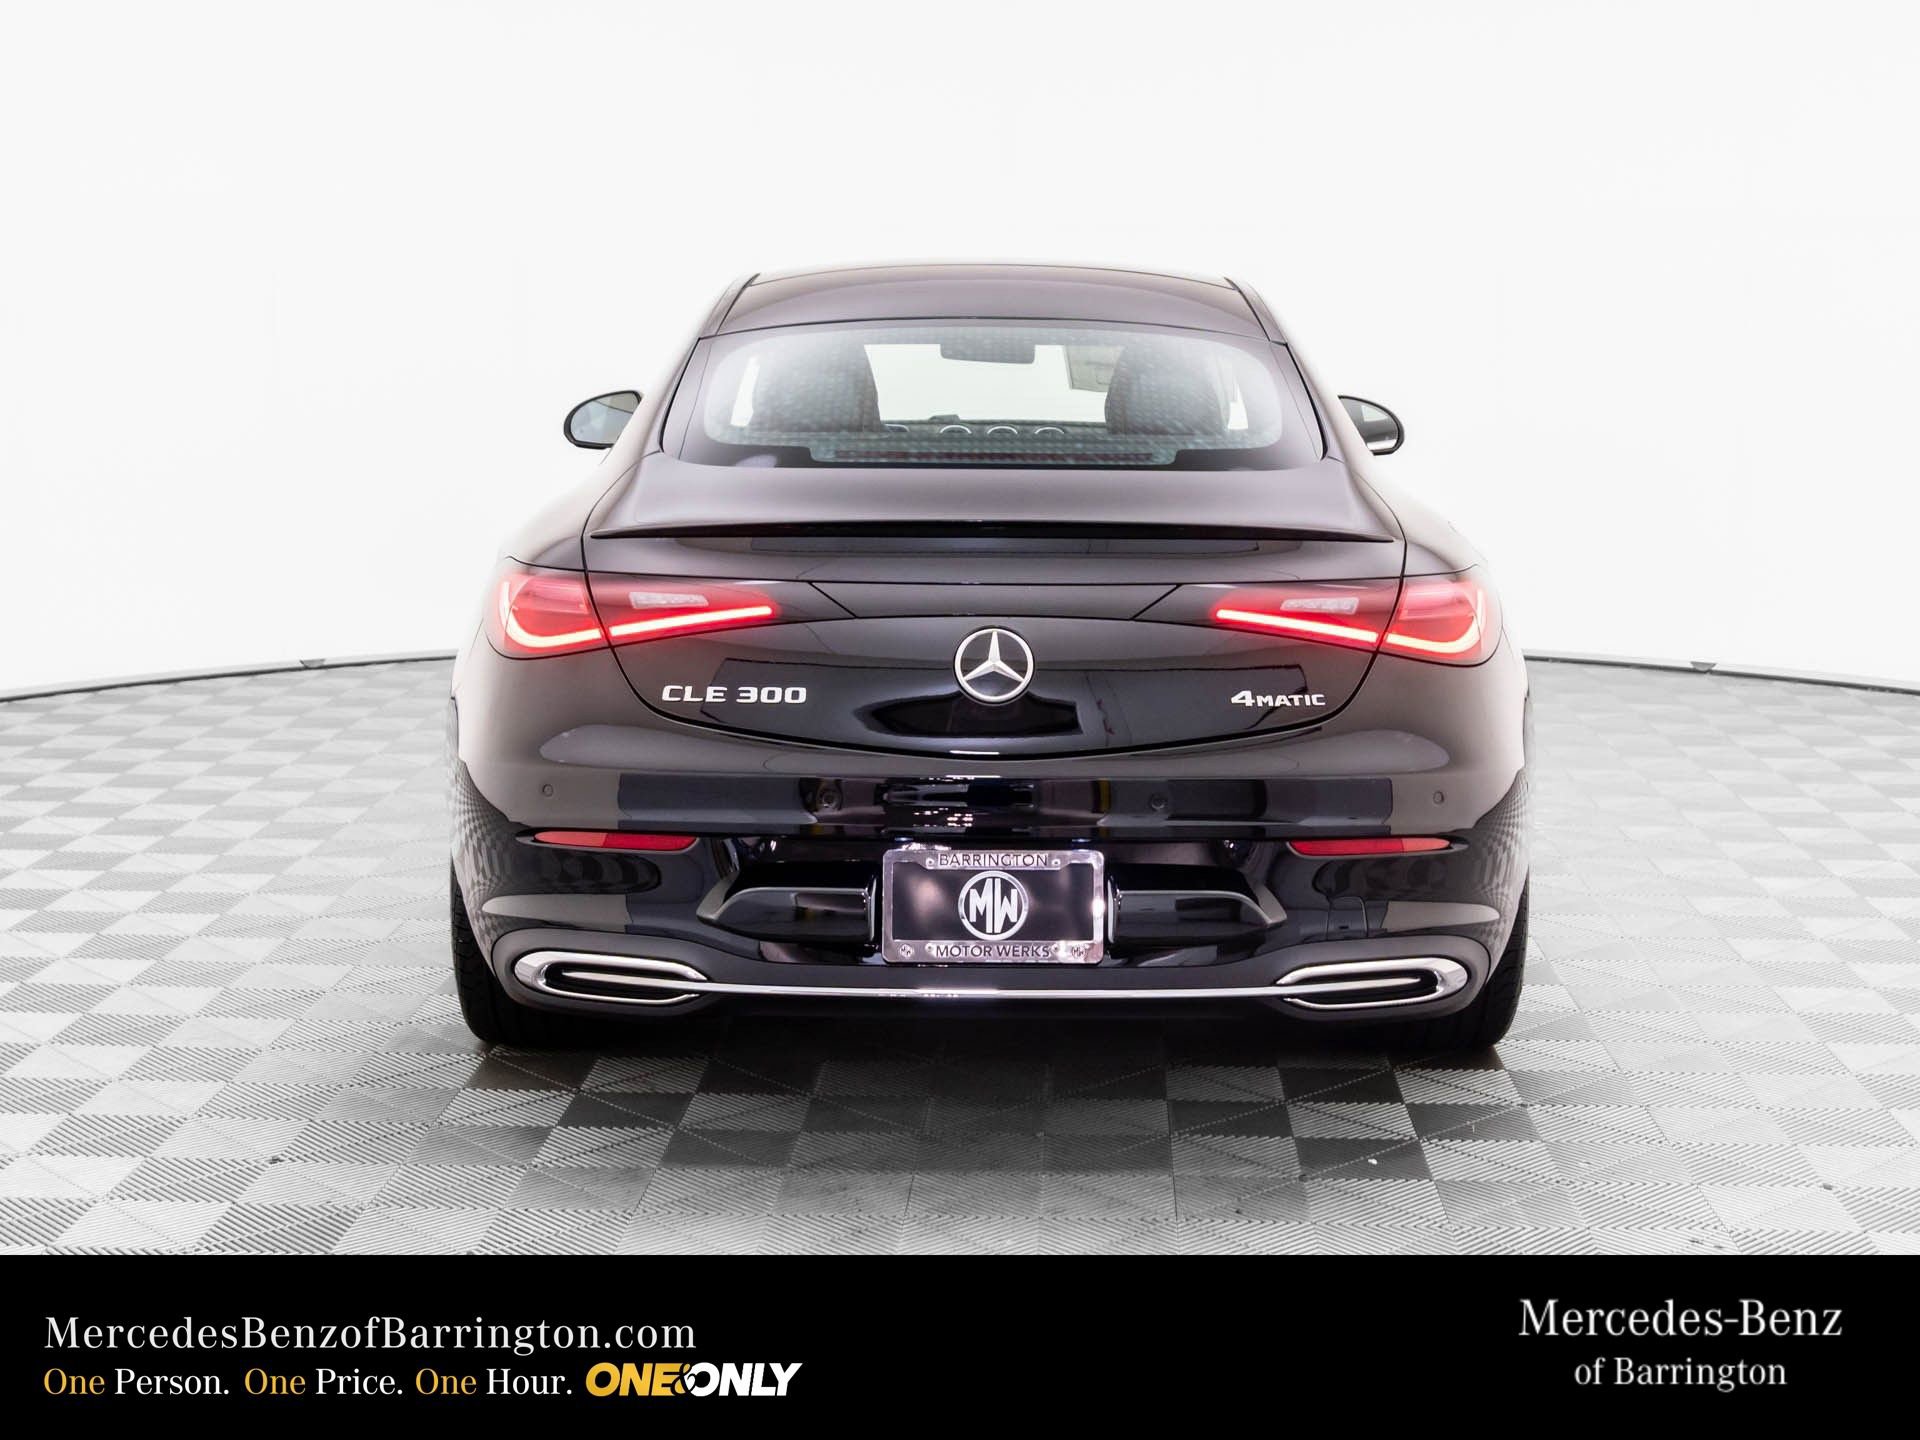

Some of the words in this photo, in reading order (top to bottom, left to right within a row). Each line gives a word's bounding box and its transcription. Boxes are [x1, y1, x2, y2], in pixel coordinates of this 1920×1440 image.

[661, 685, 728, 703] CLE
[736, 686, 807, 704] 300
[1230, 690, 1326, 707] 4MATIC
[938, 853, 1049, 867] BARRINGTON
[969, 877, 1018, 934] MW
[935, 944, 992, 957] MOTOR
[996, 944, 1050, 957] WERKS
